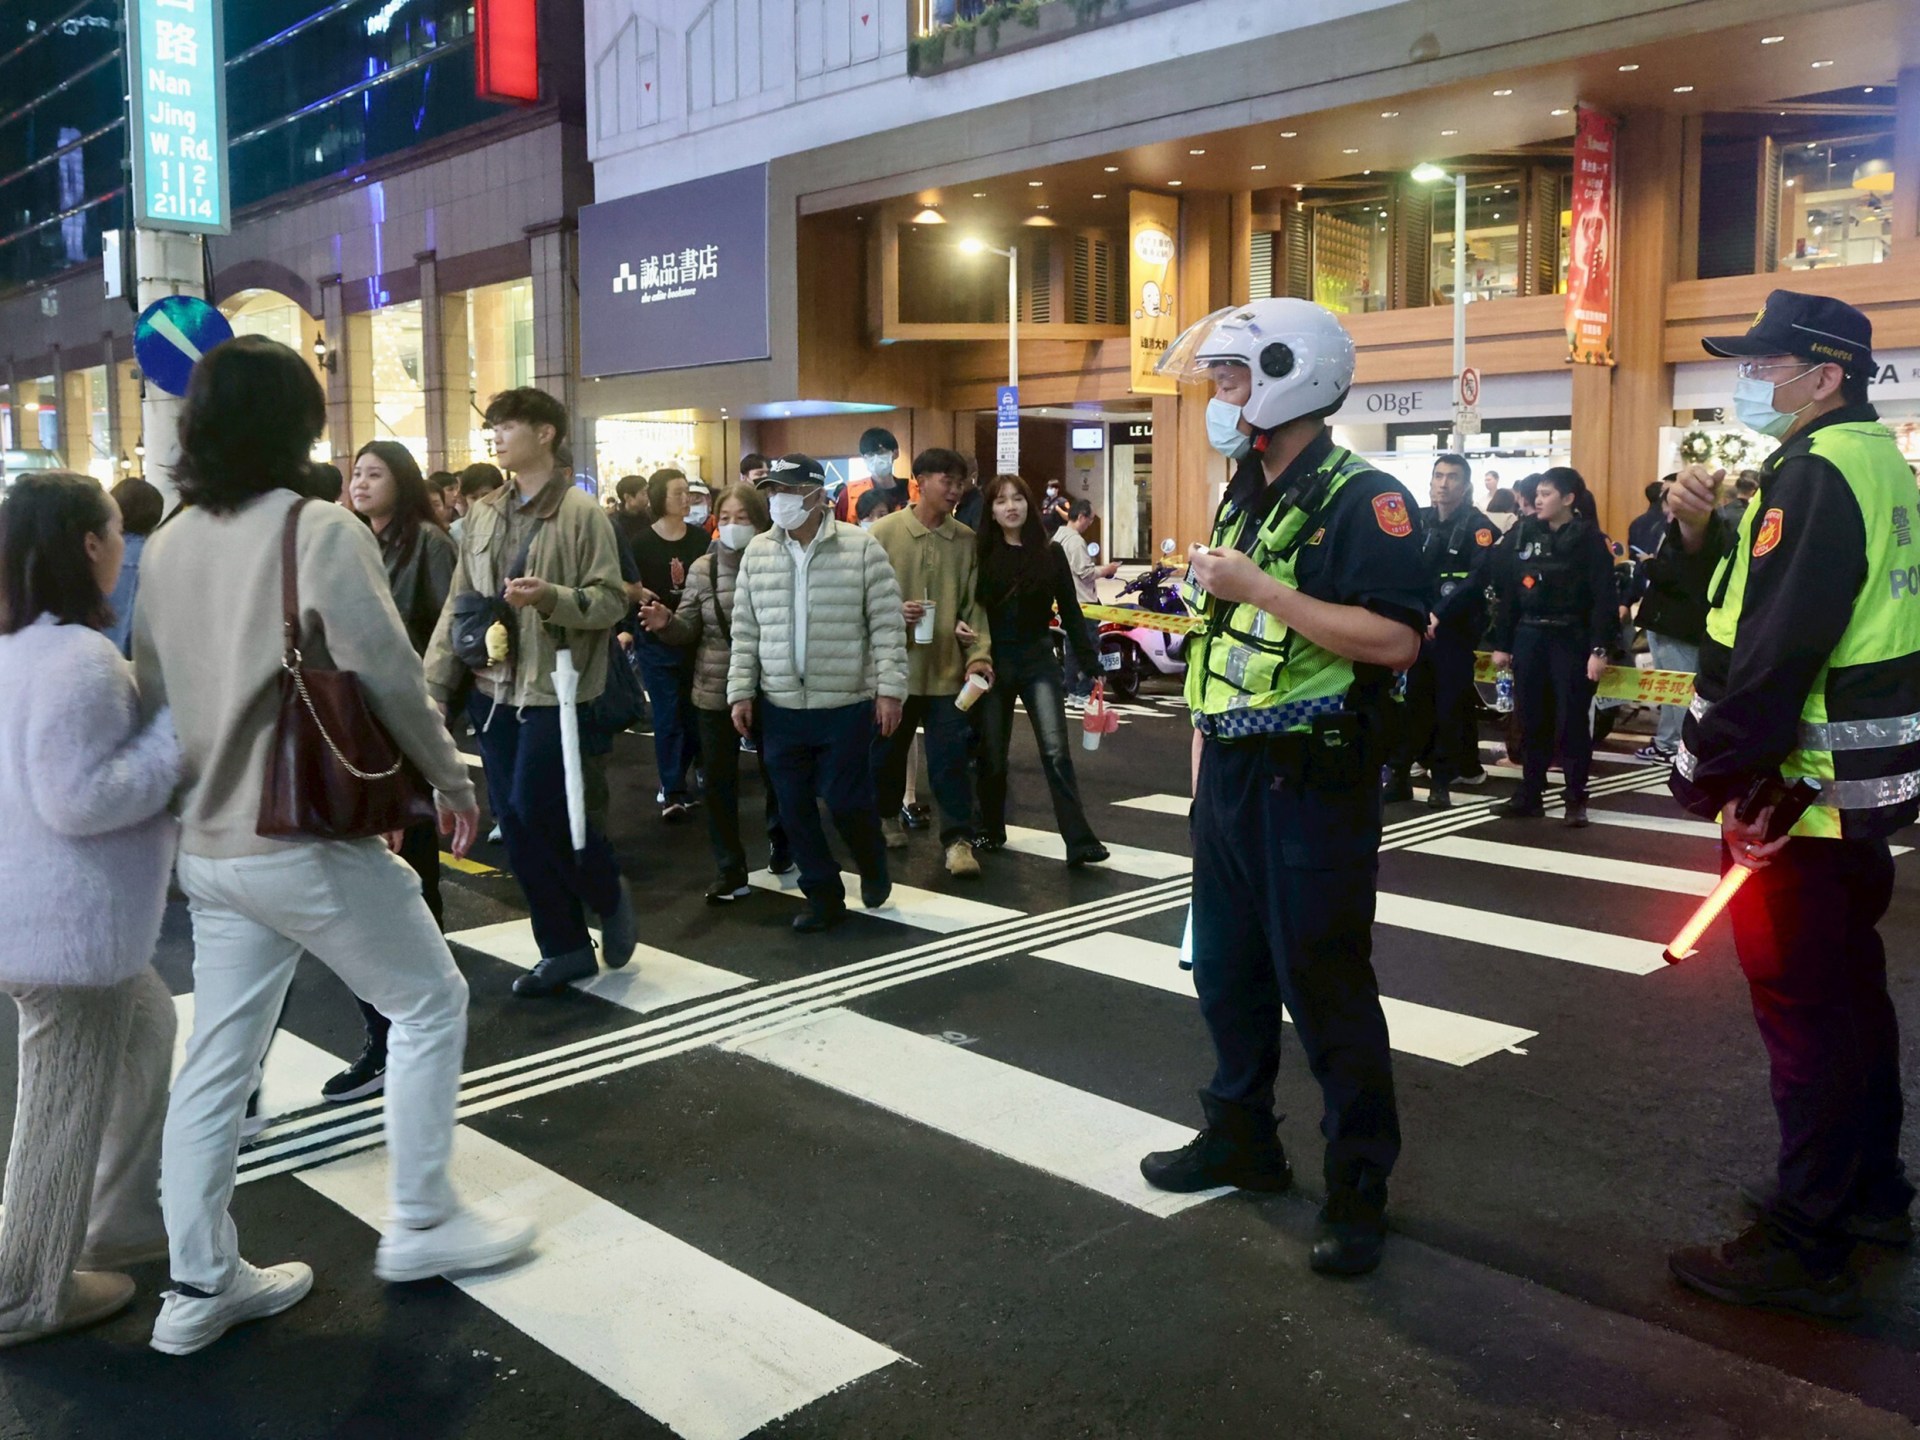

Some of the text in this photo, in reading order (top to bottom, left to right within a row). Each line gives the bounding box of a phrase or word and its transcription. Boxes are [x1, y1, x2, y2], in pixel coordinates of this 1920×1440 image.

[155, 0, 199, 67] 路
[148, 68, 192, 97] Nan
[150, 101, 196, 135] Jing
[150, 132, 213, 162] W. Rd.
[160, 161, 206, 185] 1 2
[154, 193, 211, 218] 21 14
[640, 244, 719, 290] 誠品書店
[1366, 392, 1423, 416] OBgE
[1130, 426, 1143, 437] LE
[1889, 564, 1920, 600] PO
